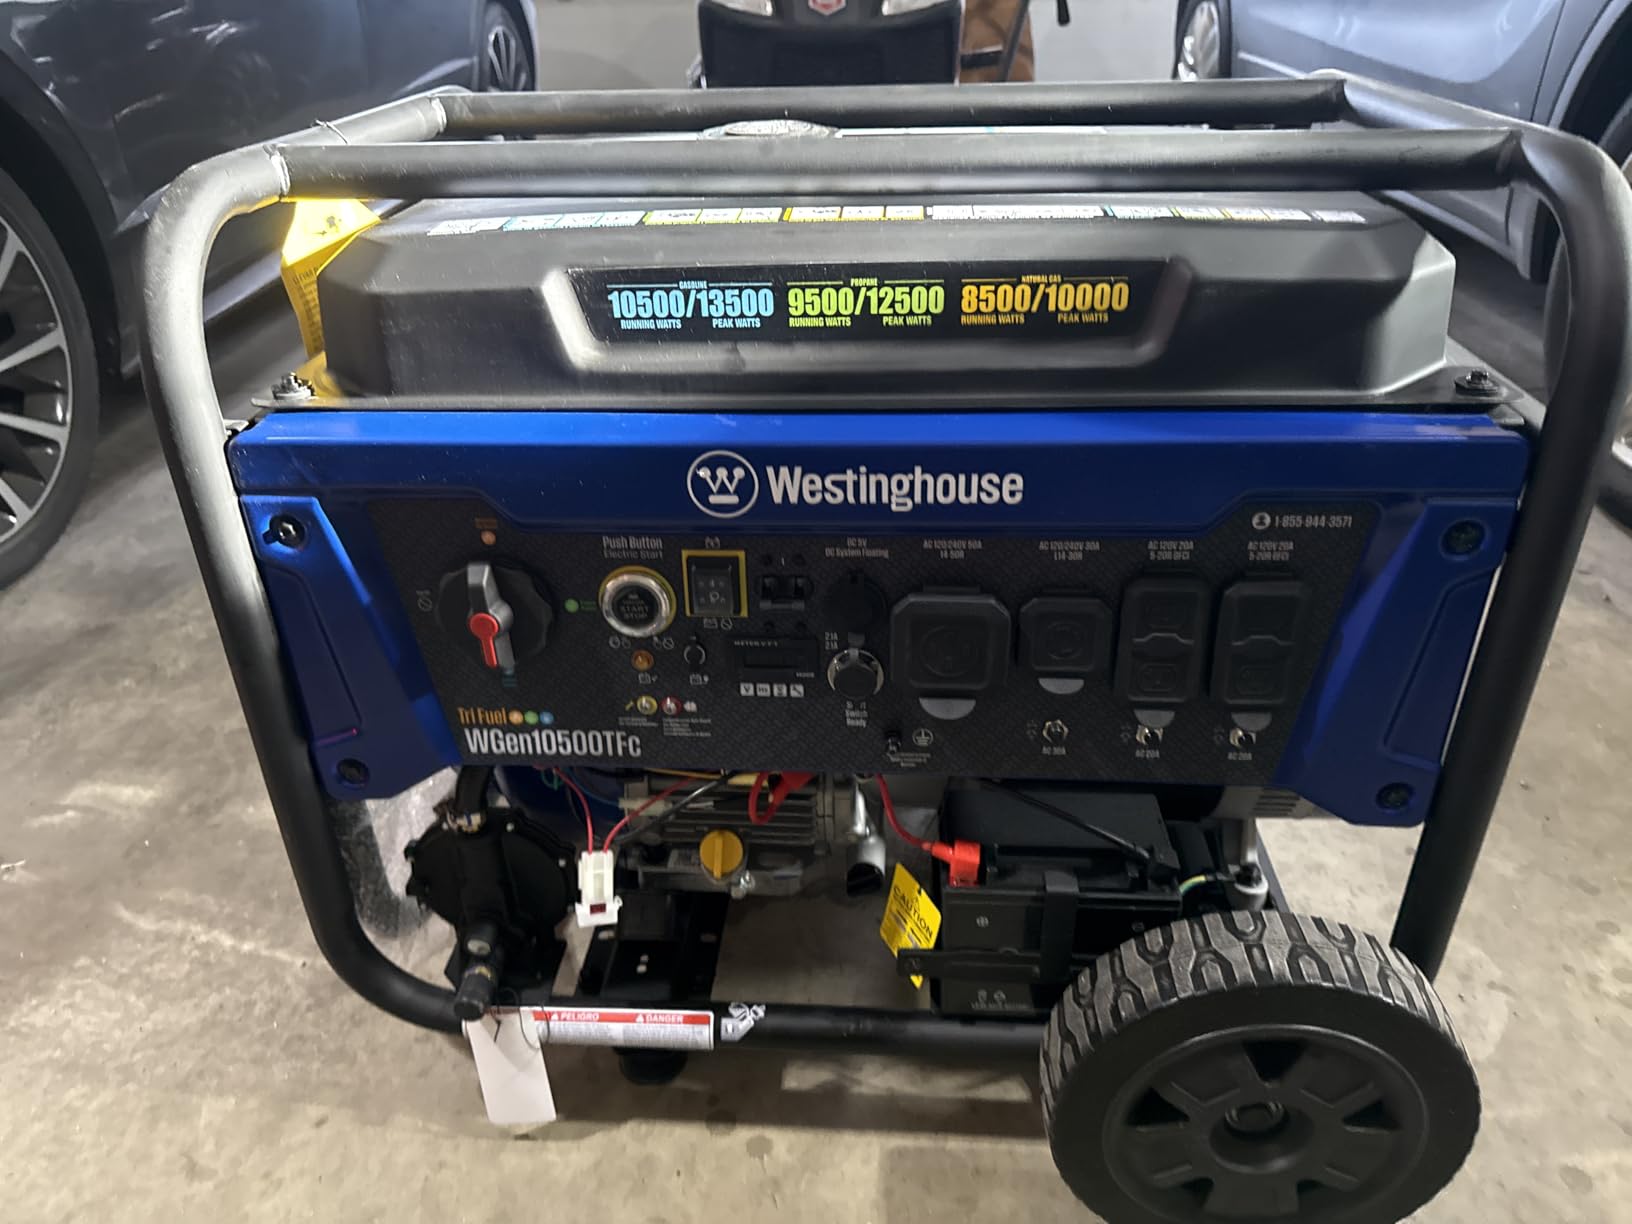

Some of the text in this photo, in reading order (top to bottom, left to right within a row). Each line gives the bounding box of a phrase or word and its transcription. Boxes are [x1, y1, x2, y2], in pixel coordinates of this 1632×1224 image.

[679, 281, 708, 290] GASOLINE
[850, 277, 878, 287] PROPANE
[608, 288, 774, 319] 10500/13500
[787, 285, 945, 316] 9500/12500
[961, 282, 1129, 313] 8500/10000
[712, 317, 762, 329] PEAK WATTS
[789, 316, 851, 328] RUNNING WATTS
[883, 315, 932, 327] PEAK WATTS
[961, 313, 1025, 326] RUNNING WATTS
[1057, 312, 1109, 324] PEAK WATTS
[621, 319, 682, 330] RUNNING WATTS
[766, 465, 1024, 512] Westinghouse
[1274, 514, 1353, 528] 1-855-944-3571
[602, 535, 663, 549] Push Button
[923, 539, 933, 550] AC
[1039, 541, 1049, 551] AC
[1147, 541, 1158, 550] AC
[1248, 541, 1258, 550] AC
[457, 706, 507, 726] Tri Fuel
[893, 886, 933, 938] CAUTION
[561, 1011, 600, 1021] PELIGRO
[645, 1014, 684, 1024] DANGER
